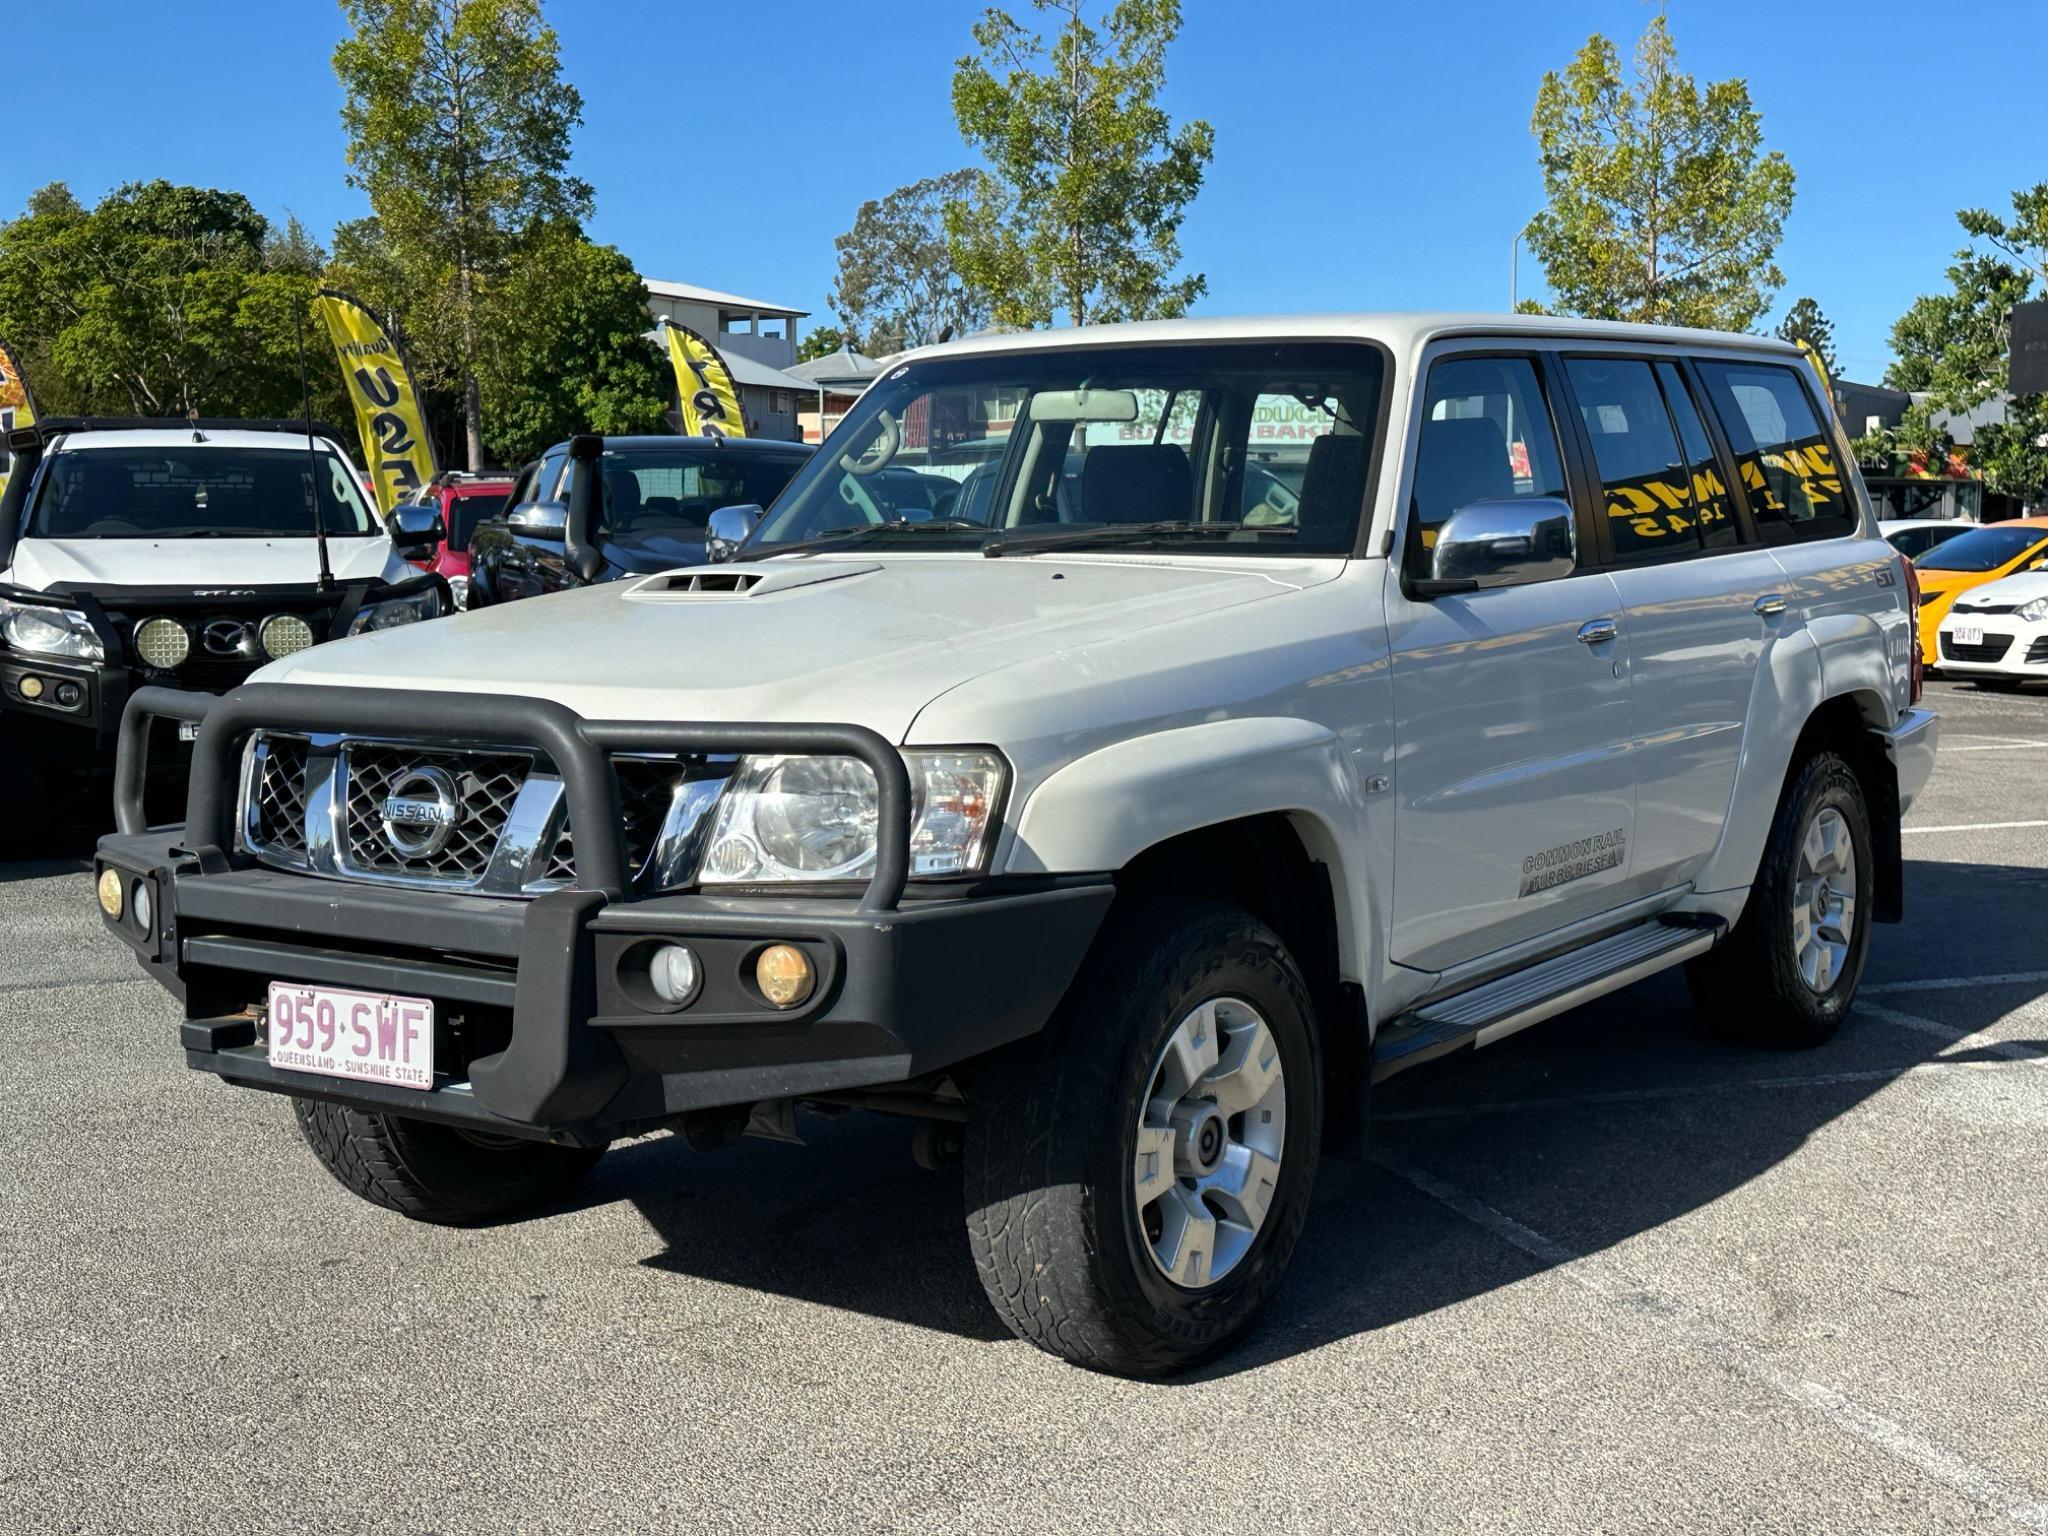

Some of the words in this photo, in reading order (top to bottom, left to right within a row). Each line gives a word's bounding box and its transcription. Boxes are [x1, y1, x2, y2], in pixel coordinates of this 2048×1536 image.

[384, 801, 443, 820] NISSAN
[1522, 836, 1592, 874] COMMON
[1592, 828, 1626, 853] RAIL
[275, 993, 336, 1053] 959
[351, 1002, 425, 1064] SWF
[276, 1051, 336, 1070] QUEENSLAND
[344, 1060, 392, 1079] SUNSHINE
[395, 1069, 424, 1083] STATE
